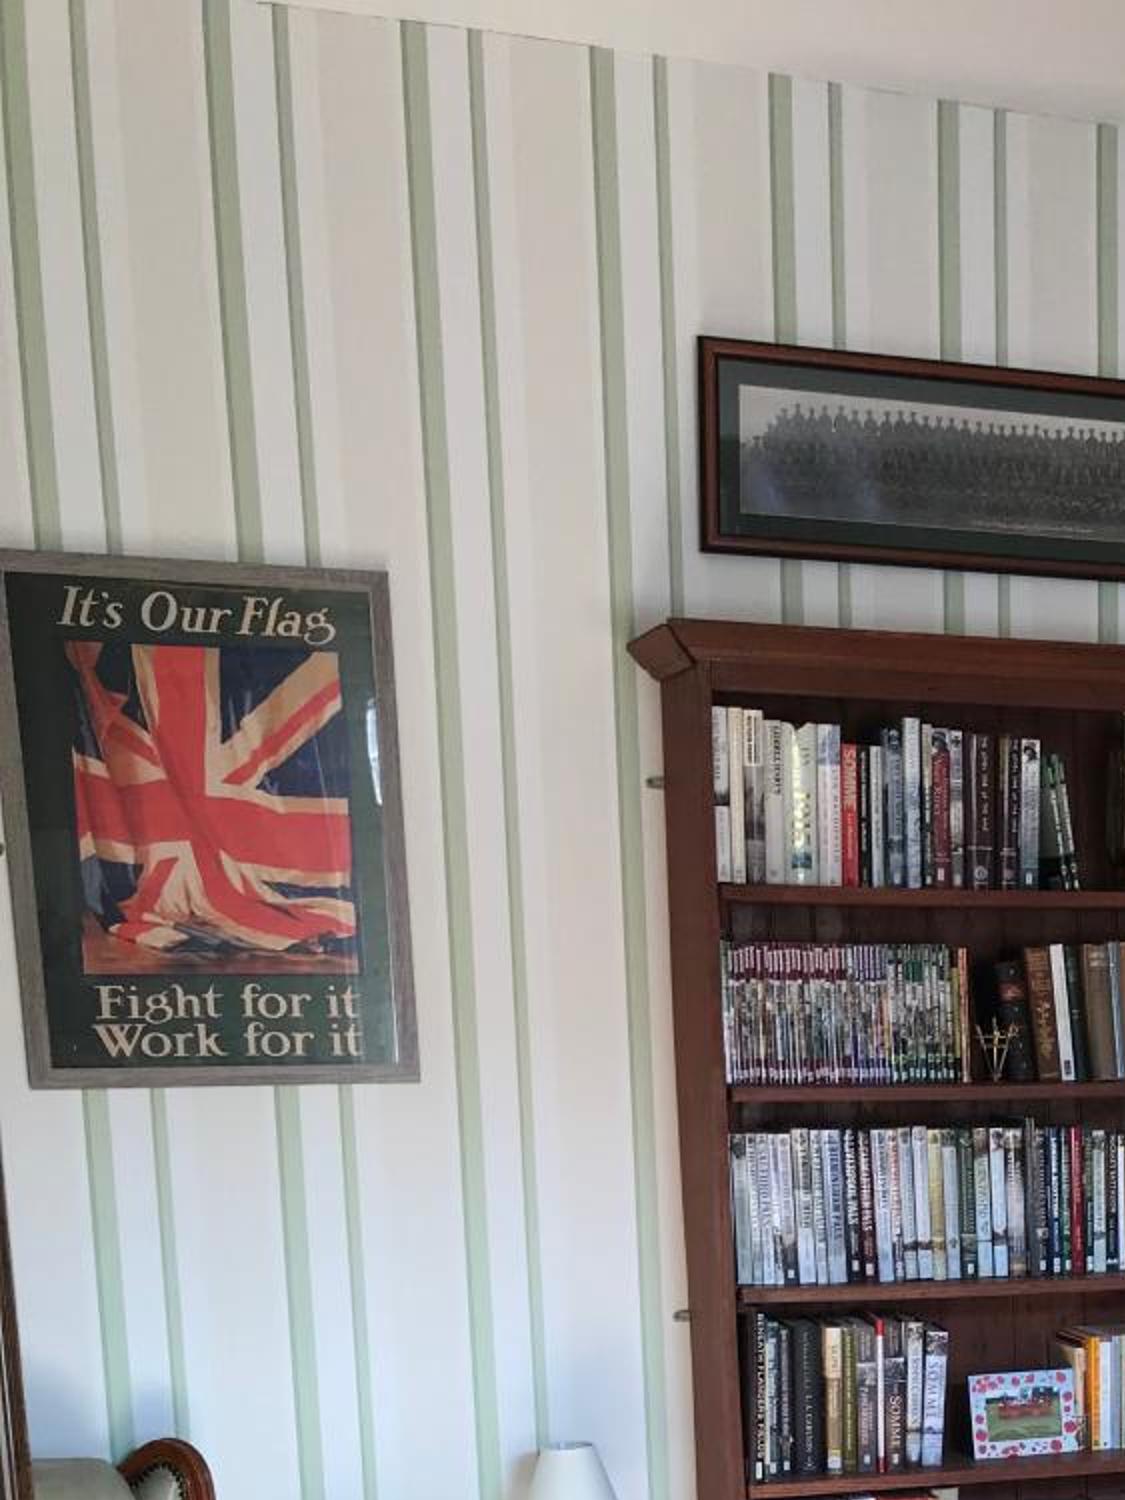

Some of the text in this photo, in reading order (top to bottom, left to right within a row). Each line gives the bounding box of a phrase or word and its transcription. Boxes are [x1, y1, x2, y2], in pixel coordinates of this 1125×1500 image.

[56, 585, 337, 646] It's Our Flag
[843, 750, 857, 811] SOMME
[95, 983, 361, 1025] Fight for it
[94, 1021, 363, 1057] Work for it
[926, 1361, 939, 1418] SOMME
[889, 1395, 902, 1448] SOMME
